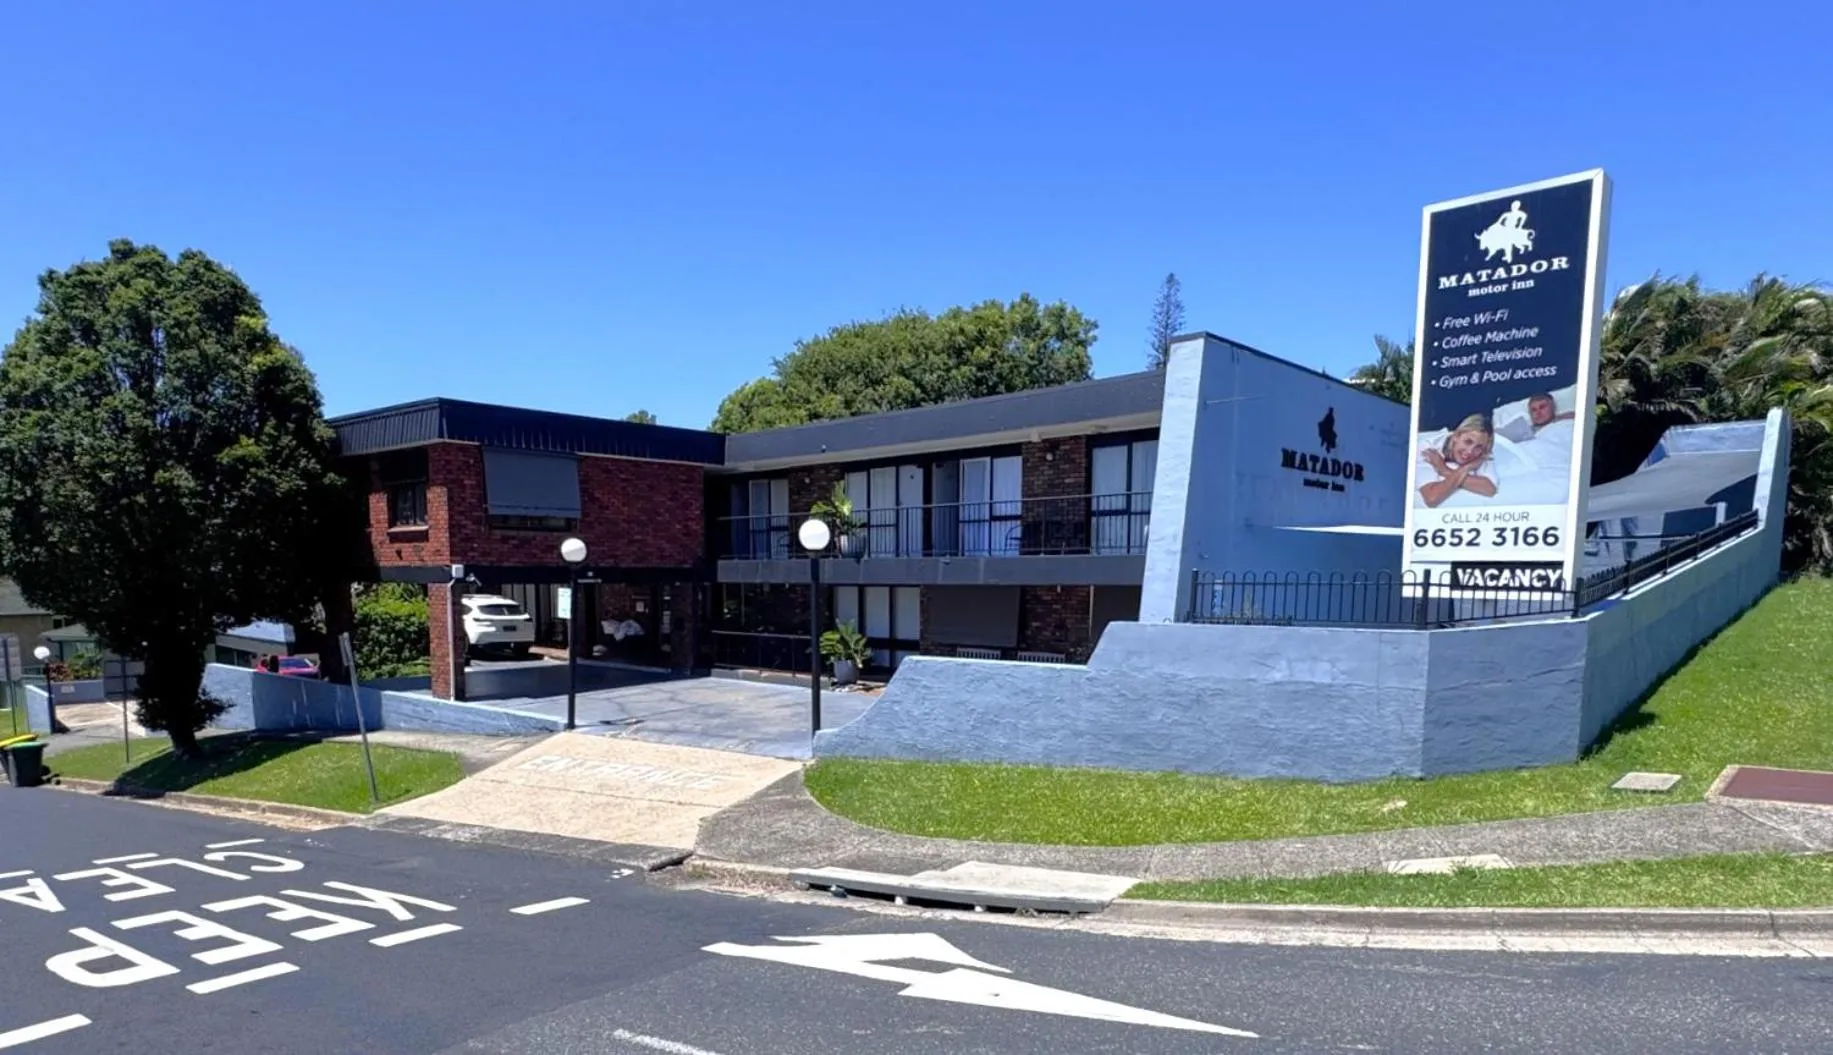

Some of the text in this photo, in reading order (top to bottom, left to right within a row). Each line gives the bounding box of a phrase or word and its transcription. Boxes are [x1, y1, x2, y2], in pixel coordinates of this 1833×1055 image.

[1438, 257, 1569, 289] MATADOR
[1468, 279, 1535, 297] motor inn
[1442, 308, 1509, 330] Free Wi-Fi
[1442, 326, 1539, 349] Coffee Machine
[1440, 346, 1542, 368] Smart Television
[1439, 366, 1557, 389] Gym & Pool access
[1280, 447, 1364, 481] MATADOR
[1442, 511, 1530, 524] CALL 24 HOUR
[1413, 526, 1560, 548] 6652 3166
[1456, 568, 1562, 588] VACANCY
[46, 881, 457, 988] KEEP
